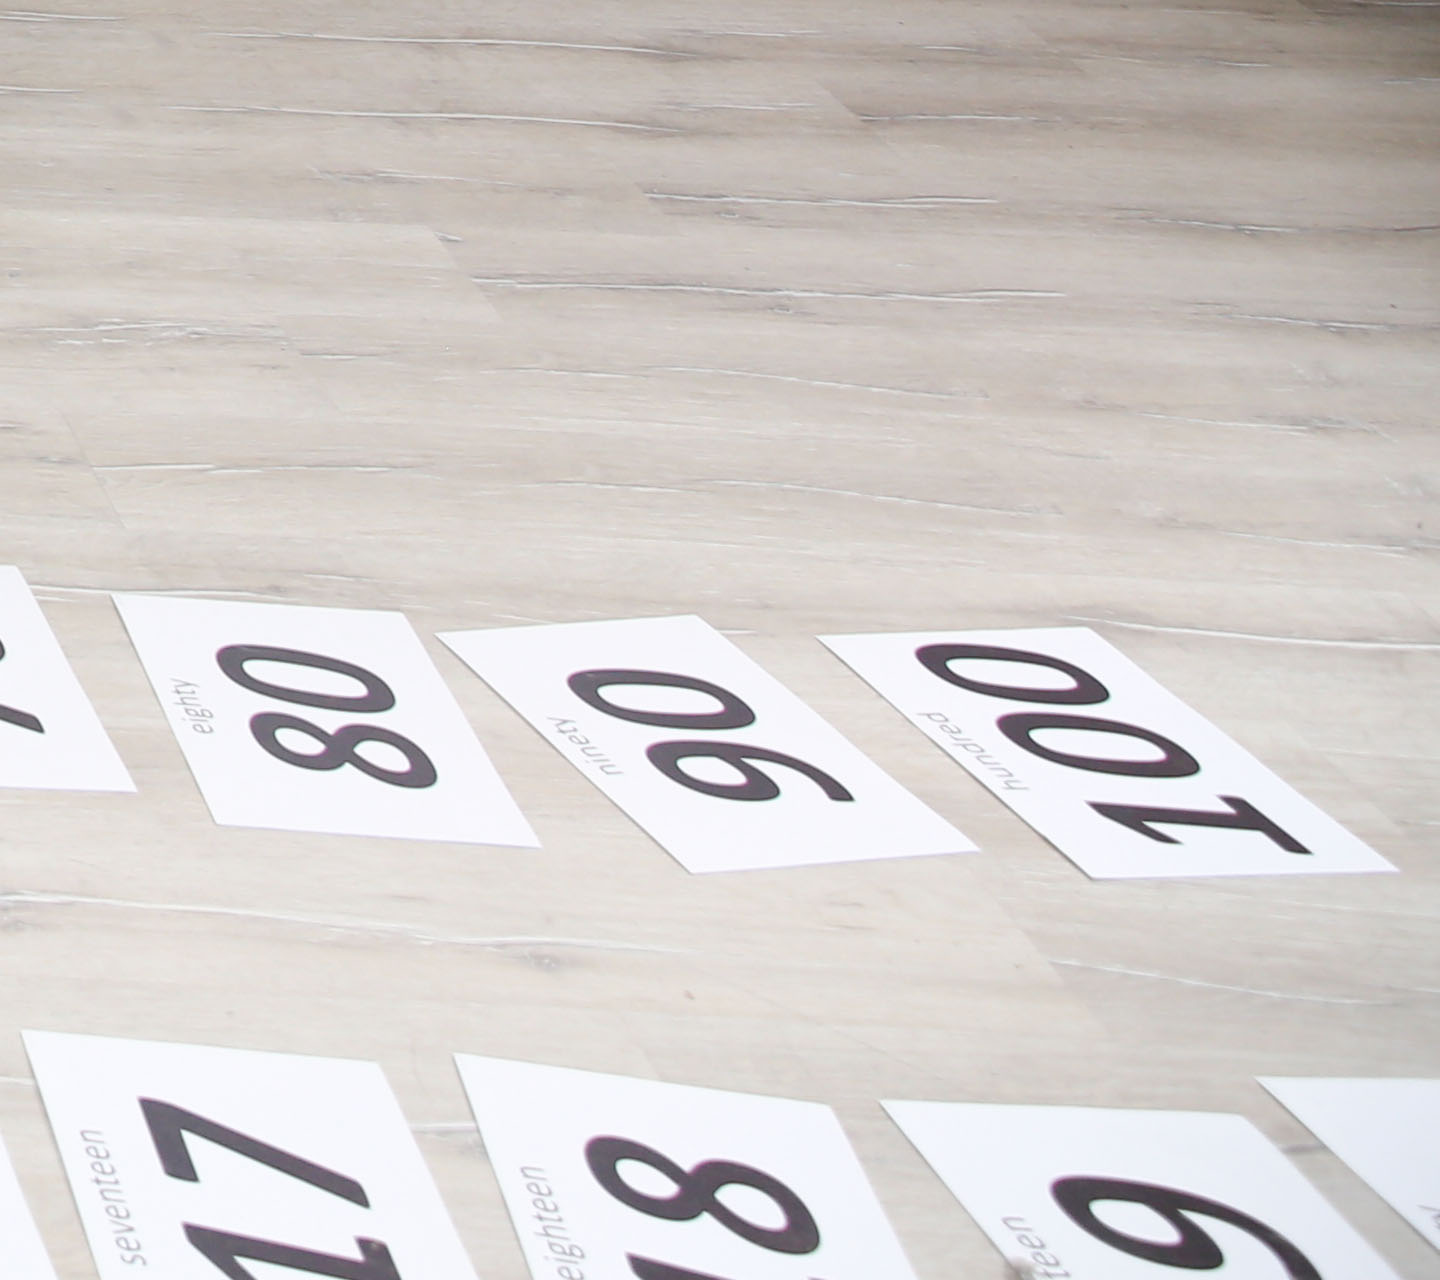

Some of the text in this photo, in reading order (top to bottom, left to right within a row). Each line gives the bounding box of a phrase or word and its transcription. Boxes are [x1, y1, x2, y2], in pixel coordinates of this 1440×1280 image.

[170, 677, 214, 735] eighty
[215, 643, 438, 789] 80
[547, 715, 625, 777] ninety
[566, 668, 855, 802] 90
[914, 642, 1314, 856] 100
[917, 712, 1030, 793] hundred
[79, 1128, 147, 1268] seventeen
[137, 1096, 402, 1280] 17
